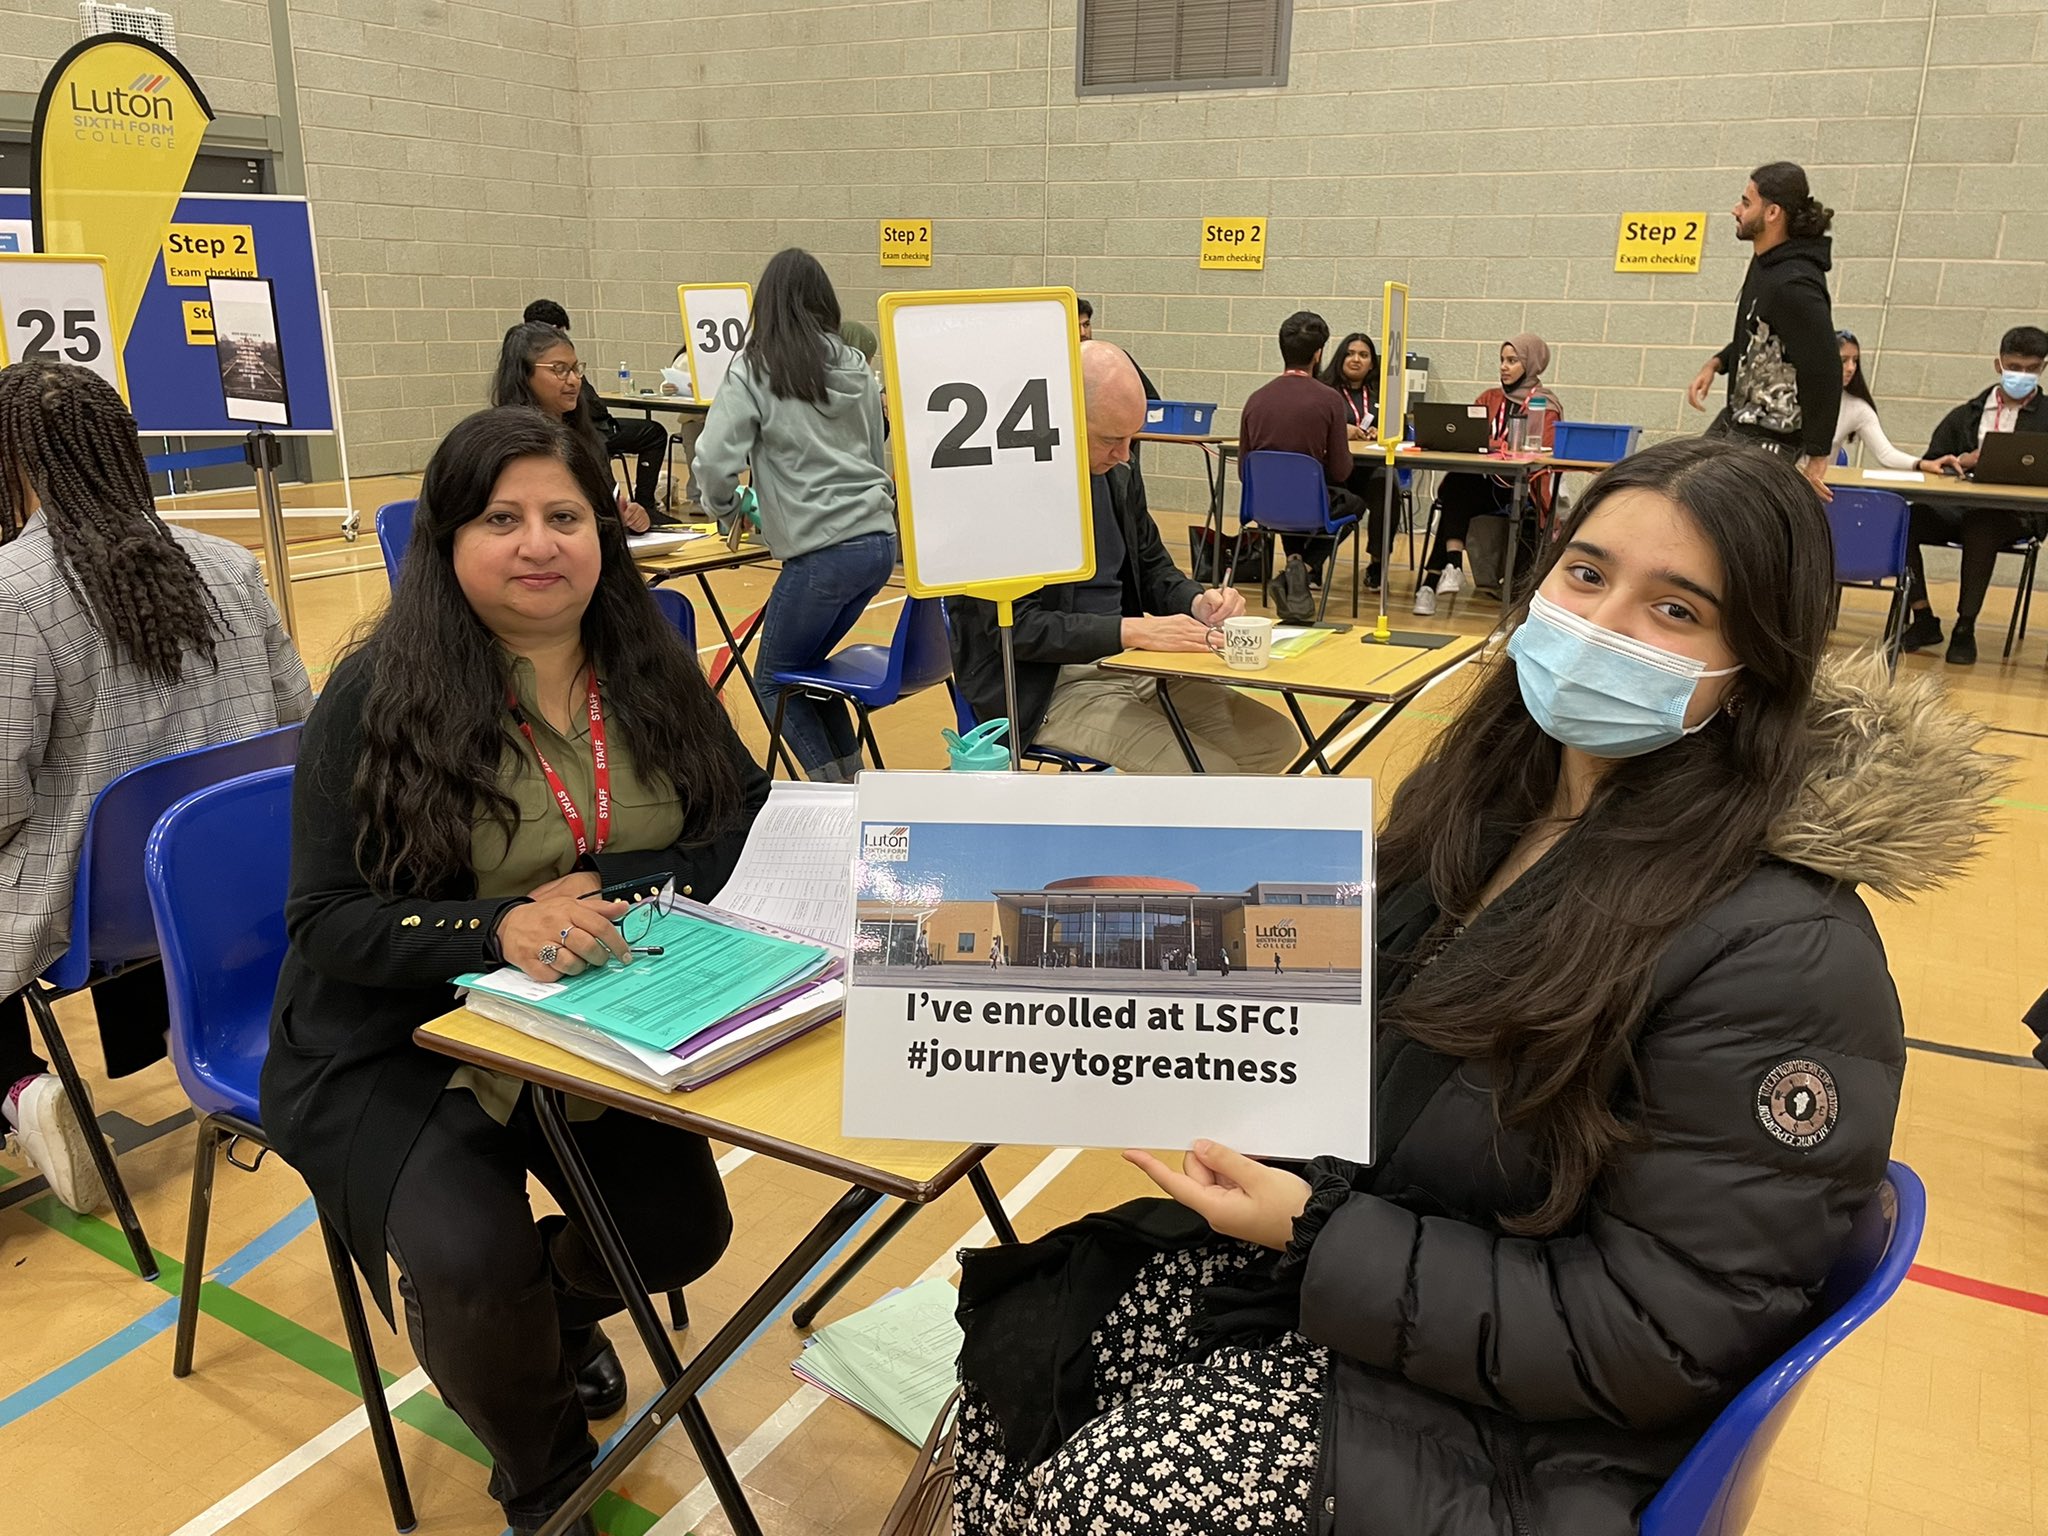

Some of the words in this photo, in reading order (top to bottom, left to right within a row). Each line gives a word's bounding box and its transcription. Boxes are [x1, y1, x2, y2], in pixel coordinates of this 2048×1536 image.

[70, 82, 173, 121] Luton
[74, 115, 124, 131] SIXTH
[129, 121, 174, 136] FORM
[75, 129, 175, 149] COLLEGE
[883, 226, 915, 245] Step
[919, 227, 928, 242] 2
[1206, 225, 1245, 246] Step
[1250, 225, 1261, 242] 2
[1625, 221, 1676, 245] Step
[1683, 221, 1697, 241] 2
[168, 233, 225, 259] Step
[232, 234, 248, 255] 2
[882, 251, 900, 260] Exam
[901, 251, 930, 262] checking
[1203, 253, 1225, 262] Exam
[1226, 253, 1261, 264] checking
[170, 267, 201, 277] Exam
[1620, 254, 1648, 264] Exam
[1650, 253, 1697, 266] checking
[17, 309, 102, 363] 25
[696, 317, 747, 354] 30
[927, 378, 1060, 469] 24
[590, 692, 601, 721] STAFF
[594, 739, 606, 769] STAFF
[557, 790, 578, 820] STAFF
[598, 788, 609, 819] STAFF
[864, 833, 908, 848] Luton
[1256, 924, 1297, 938] Luton
[906, 992, 972, 1023] I've
[982, 997, 1136, 1029] enrolled
[1147, 1003, 1184, 1031] at
[1194, 1002, 1300, 1036] LSFC!
[907, 1038, 1298, 1086] #journeytogreatness
